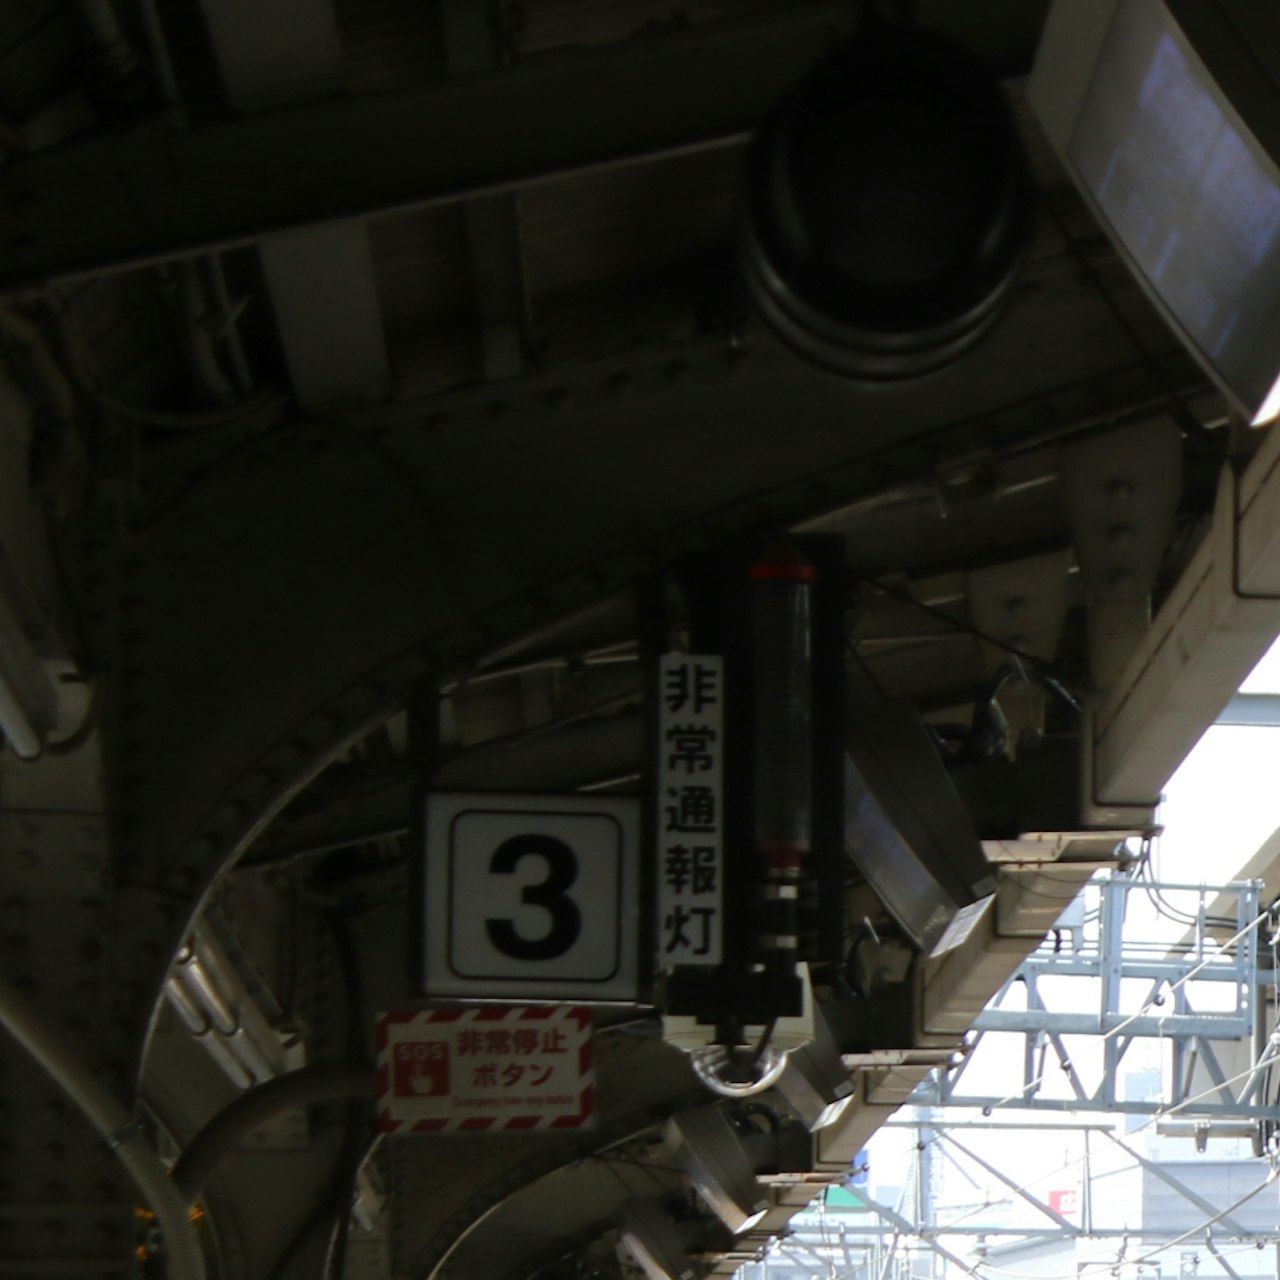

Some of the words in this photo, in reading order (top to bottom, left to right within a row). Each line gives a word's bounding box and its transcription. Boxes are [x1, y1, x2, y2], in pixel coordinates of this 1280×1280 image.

[665, 663, 717, 955] 非常通報灯
[486, 833, 582, 961] 3
[399, 1044, 444, 1061] SOS
[457, 1027, 568, 1057] 非常停止
[472, 1062, 554, 1088] ボタン
